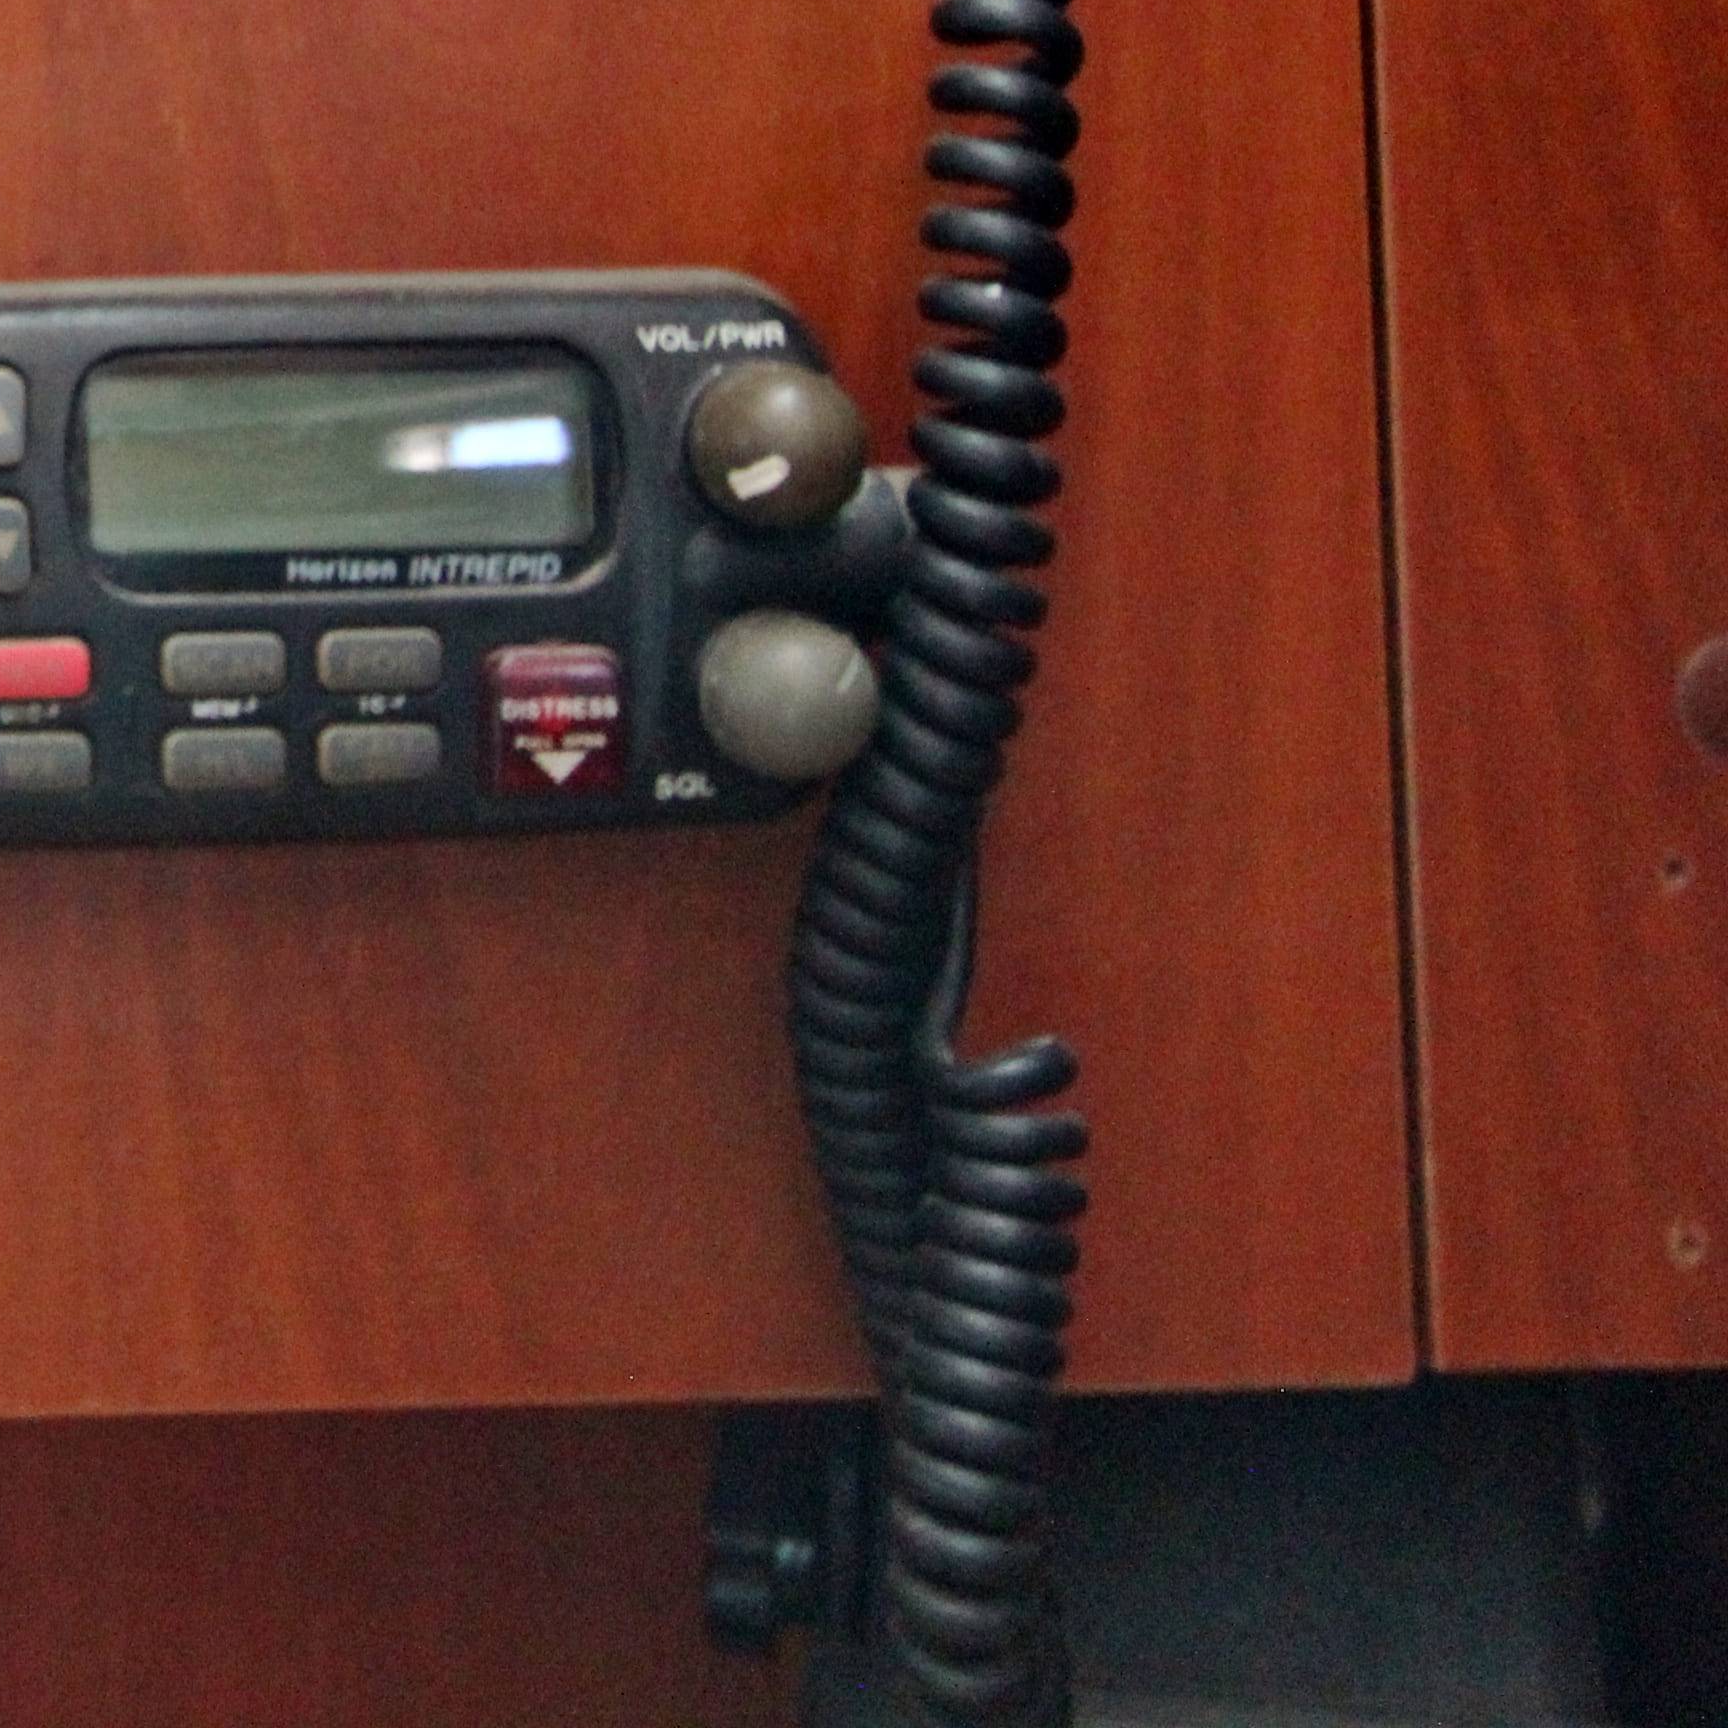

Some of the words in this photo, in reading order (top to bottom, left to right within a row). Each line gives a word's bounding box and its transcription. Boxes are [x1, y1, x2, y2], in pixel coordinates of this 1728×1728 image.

[636, 319, 787, 353] VOL/PWR
[287, 557, 397, 584] Horizon
[408, 553, 563, 585] INTREPID
[500, 695, 619, 722] DISTRESS
